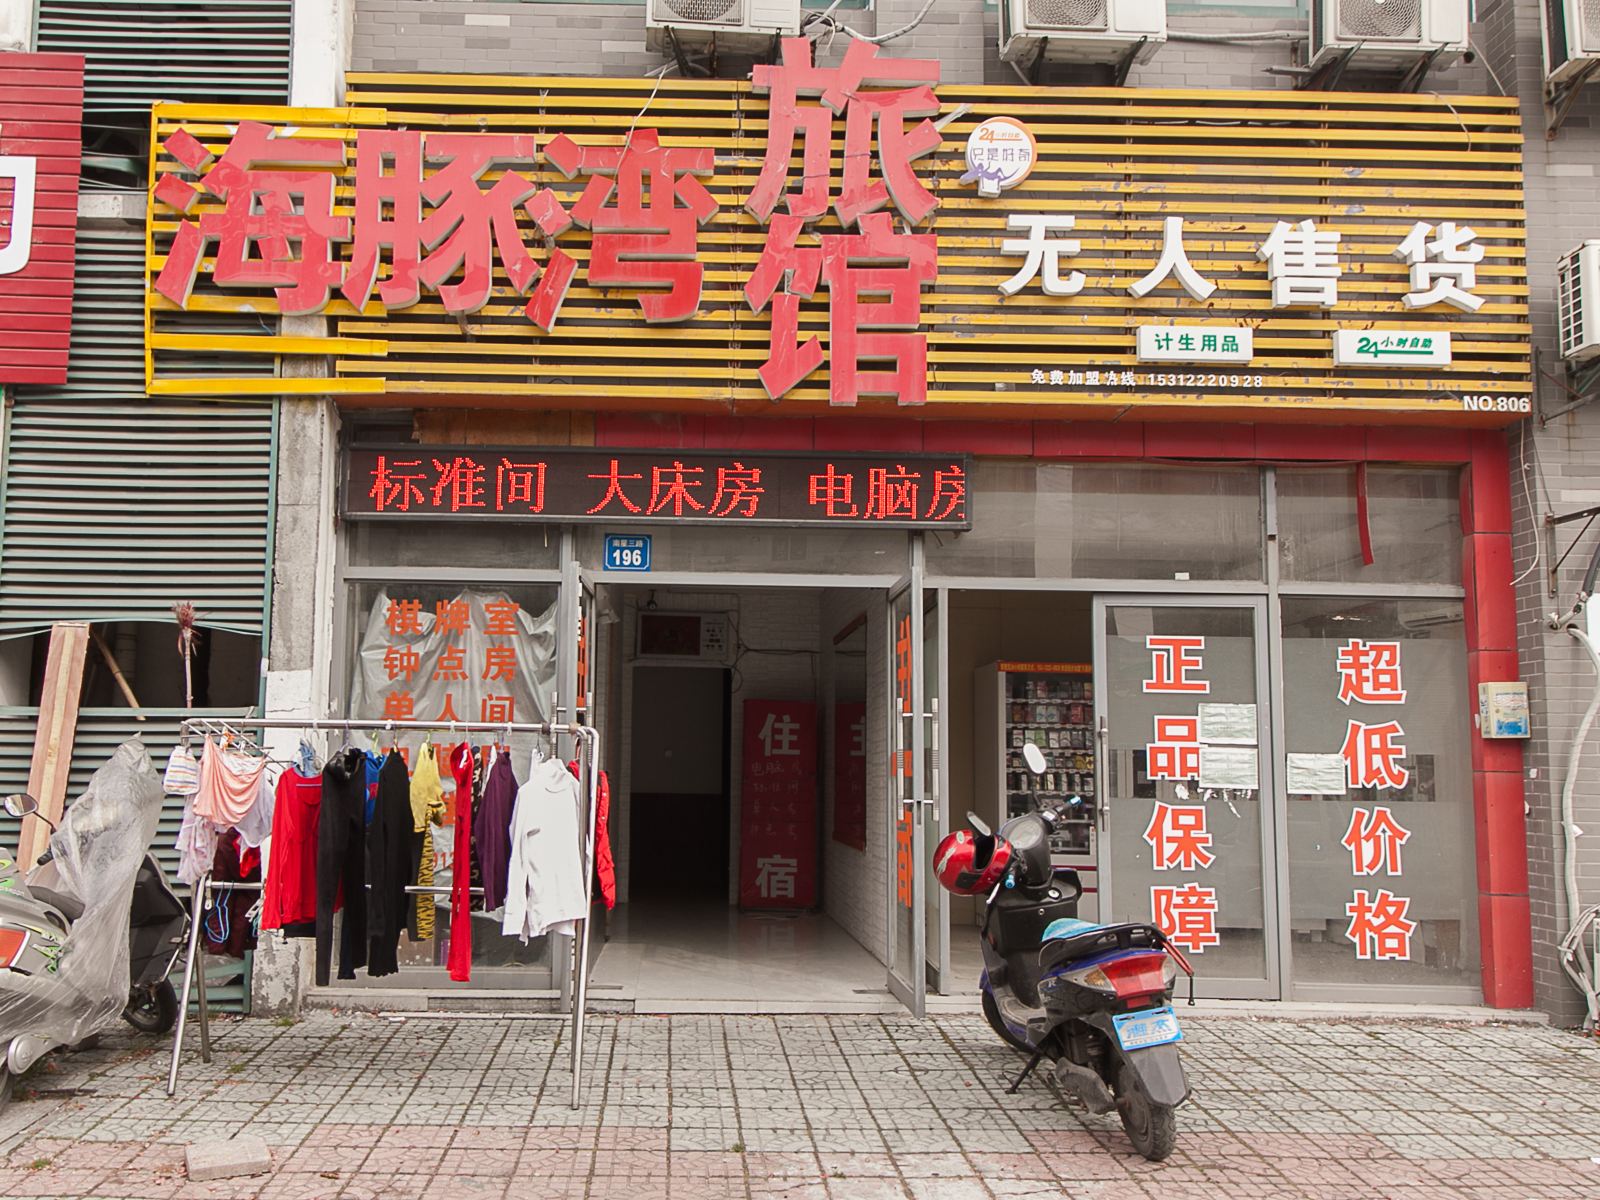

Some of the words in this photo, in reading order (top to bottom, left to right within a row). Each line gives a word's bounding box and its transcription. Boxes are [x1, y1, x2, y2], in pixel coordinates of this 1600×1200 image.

[154, 119, 720, 335] 海豚湾
[744, 37, 943, 407] 旅馆
[998, 213, 1487, 313] 无人售货
[1154, 332, 1240, 353] 计生用品
[1147, 372, 1264, 389] 15312220928
[1462, 395, 1531, 413] NO.806
[368, 456, 548, 513] 标准间
[587, 459, 765, 518] 大床房
[808, 463, 966, 520] 电脑房
[613, 549, 642, 566] 196
[384, 598, 521, 637] 棋牌室
[383, 645, 518, 682] 钟点房
[380, 690, 516, 723] 单人间
[1143, 635, 1220, 953] 正品保障
[1337, 638, 1417, 960] 超低价格
